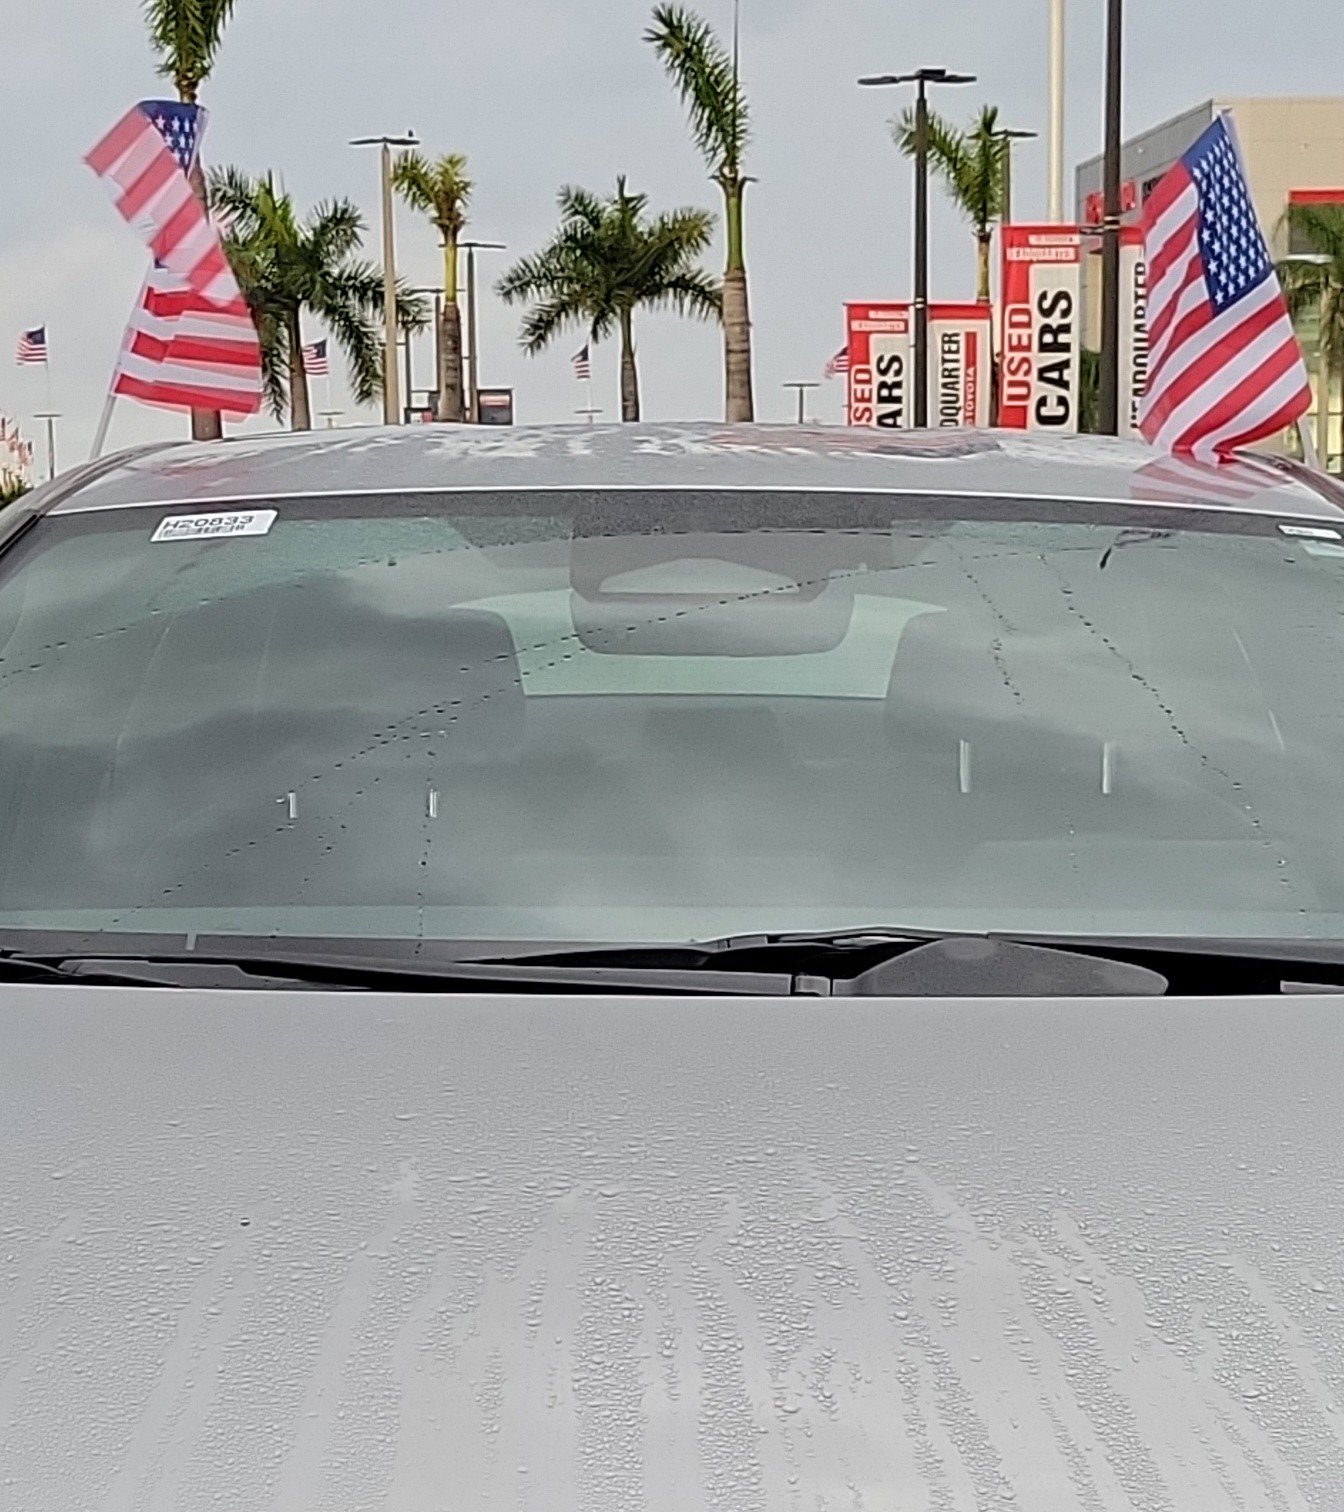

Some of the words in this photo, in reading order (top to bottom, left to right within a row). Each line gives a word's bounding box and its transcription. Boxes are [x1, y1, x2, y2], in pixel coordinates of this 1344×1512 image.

[852, 365, 873, 427] SED
[876, 354, 903, 428] ARS
[940, 332, 962, 427] DQUARTER
[1004, 304, 1033, 405] USED
[1035, 290, 1073, 426] CARS
